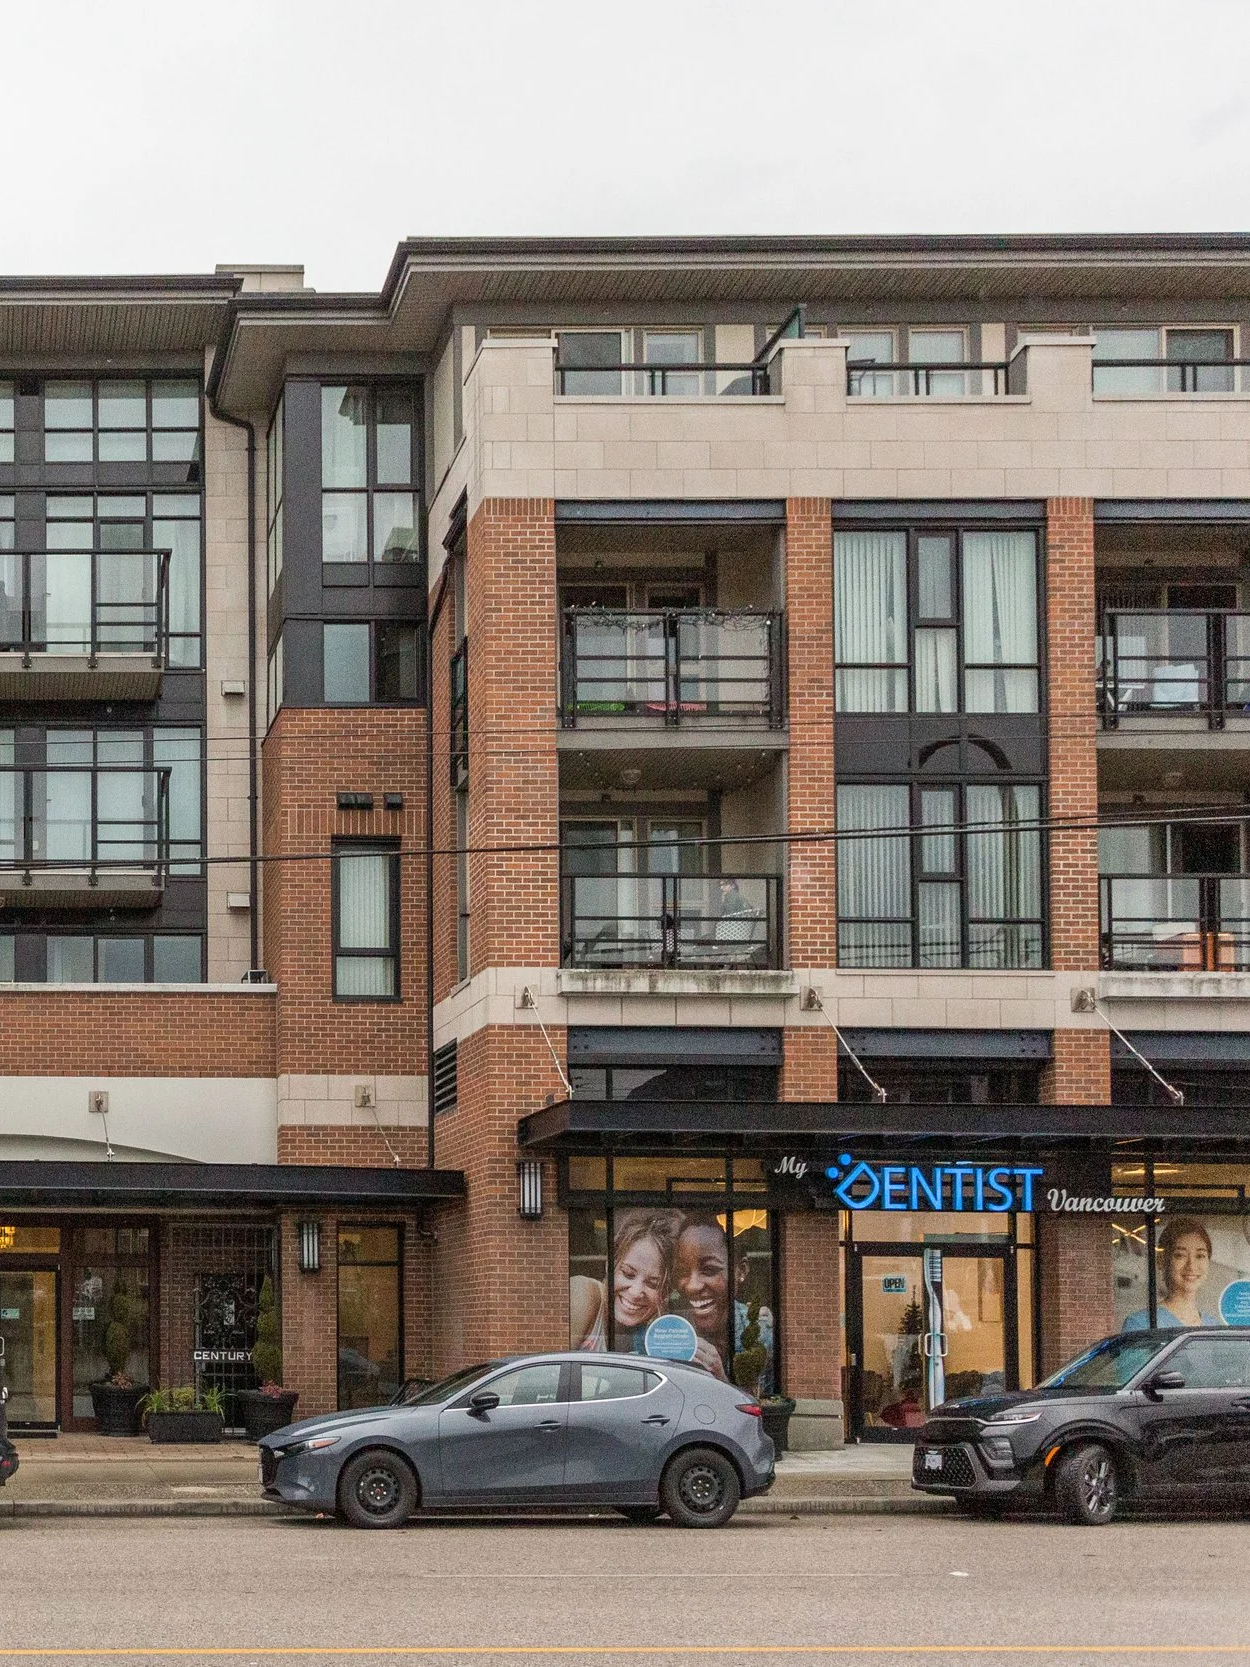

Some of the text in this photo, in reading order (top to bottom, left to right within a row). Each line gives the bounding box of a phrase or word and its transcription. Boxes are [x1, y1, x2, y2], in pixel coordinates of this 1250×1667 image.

[774, 1156, 1165, 1213] My DENTIST Vancouver
[193, 1351, 253, 1361] CENTURY
